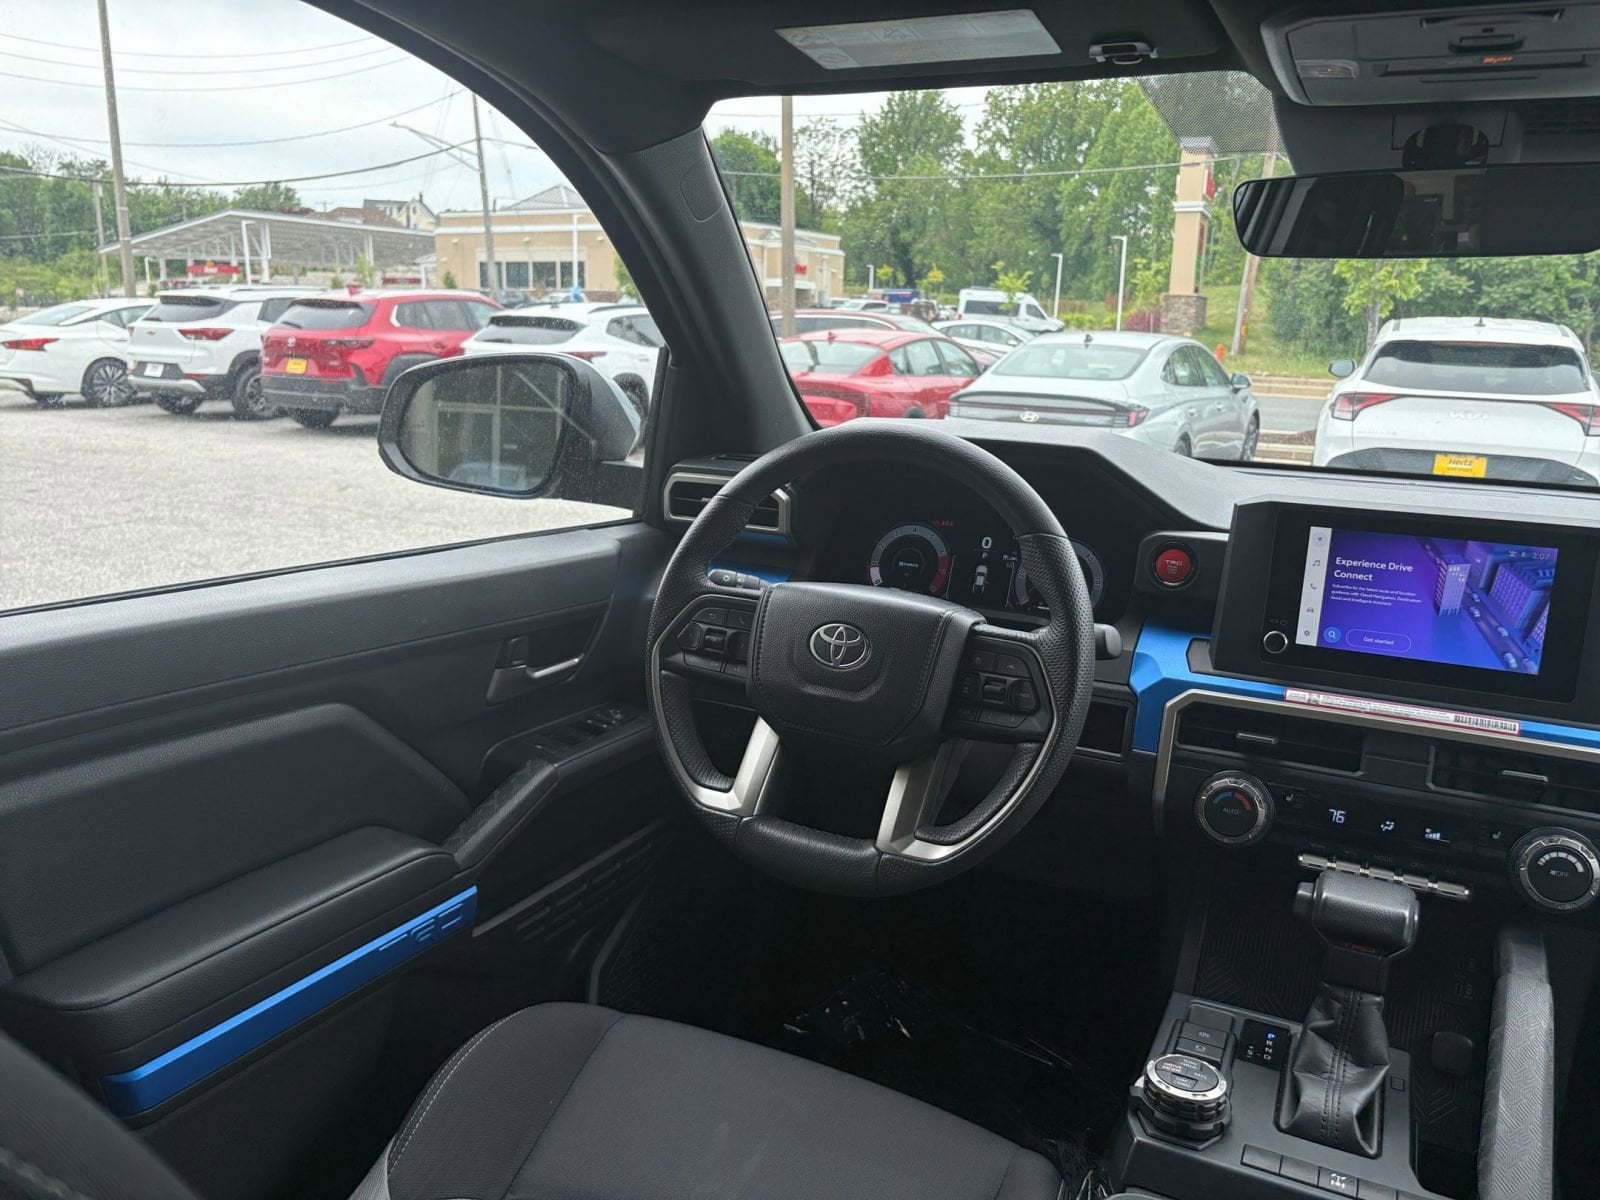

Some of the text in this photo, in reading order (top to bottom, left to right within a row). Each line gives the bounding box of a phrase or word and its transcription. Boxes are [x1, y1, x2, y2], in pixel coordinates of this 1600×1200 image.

[1448, 458, 1474, 467] Hertz
[982, 536, 992, 549] 0
[1335, 557, 1414, 572] Experience Drive
[1333, 570, 1373, 581] Connect
[1222, 807, 1240, 815] AUTO
[1328, 809, 1346, 824] 76
